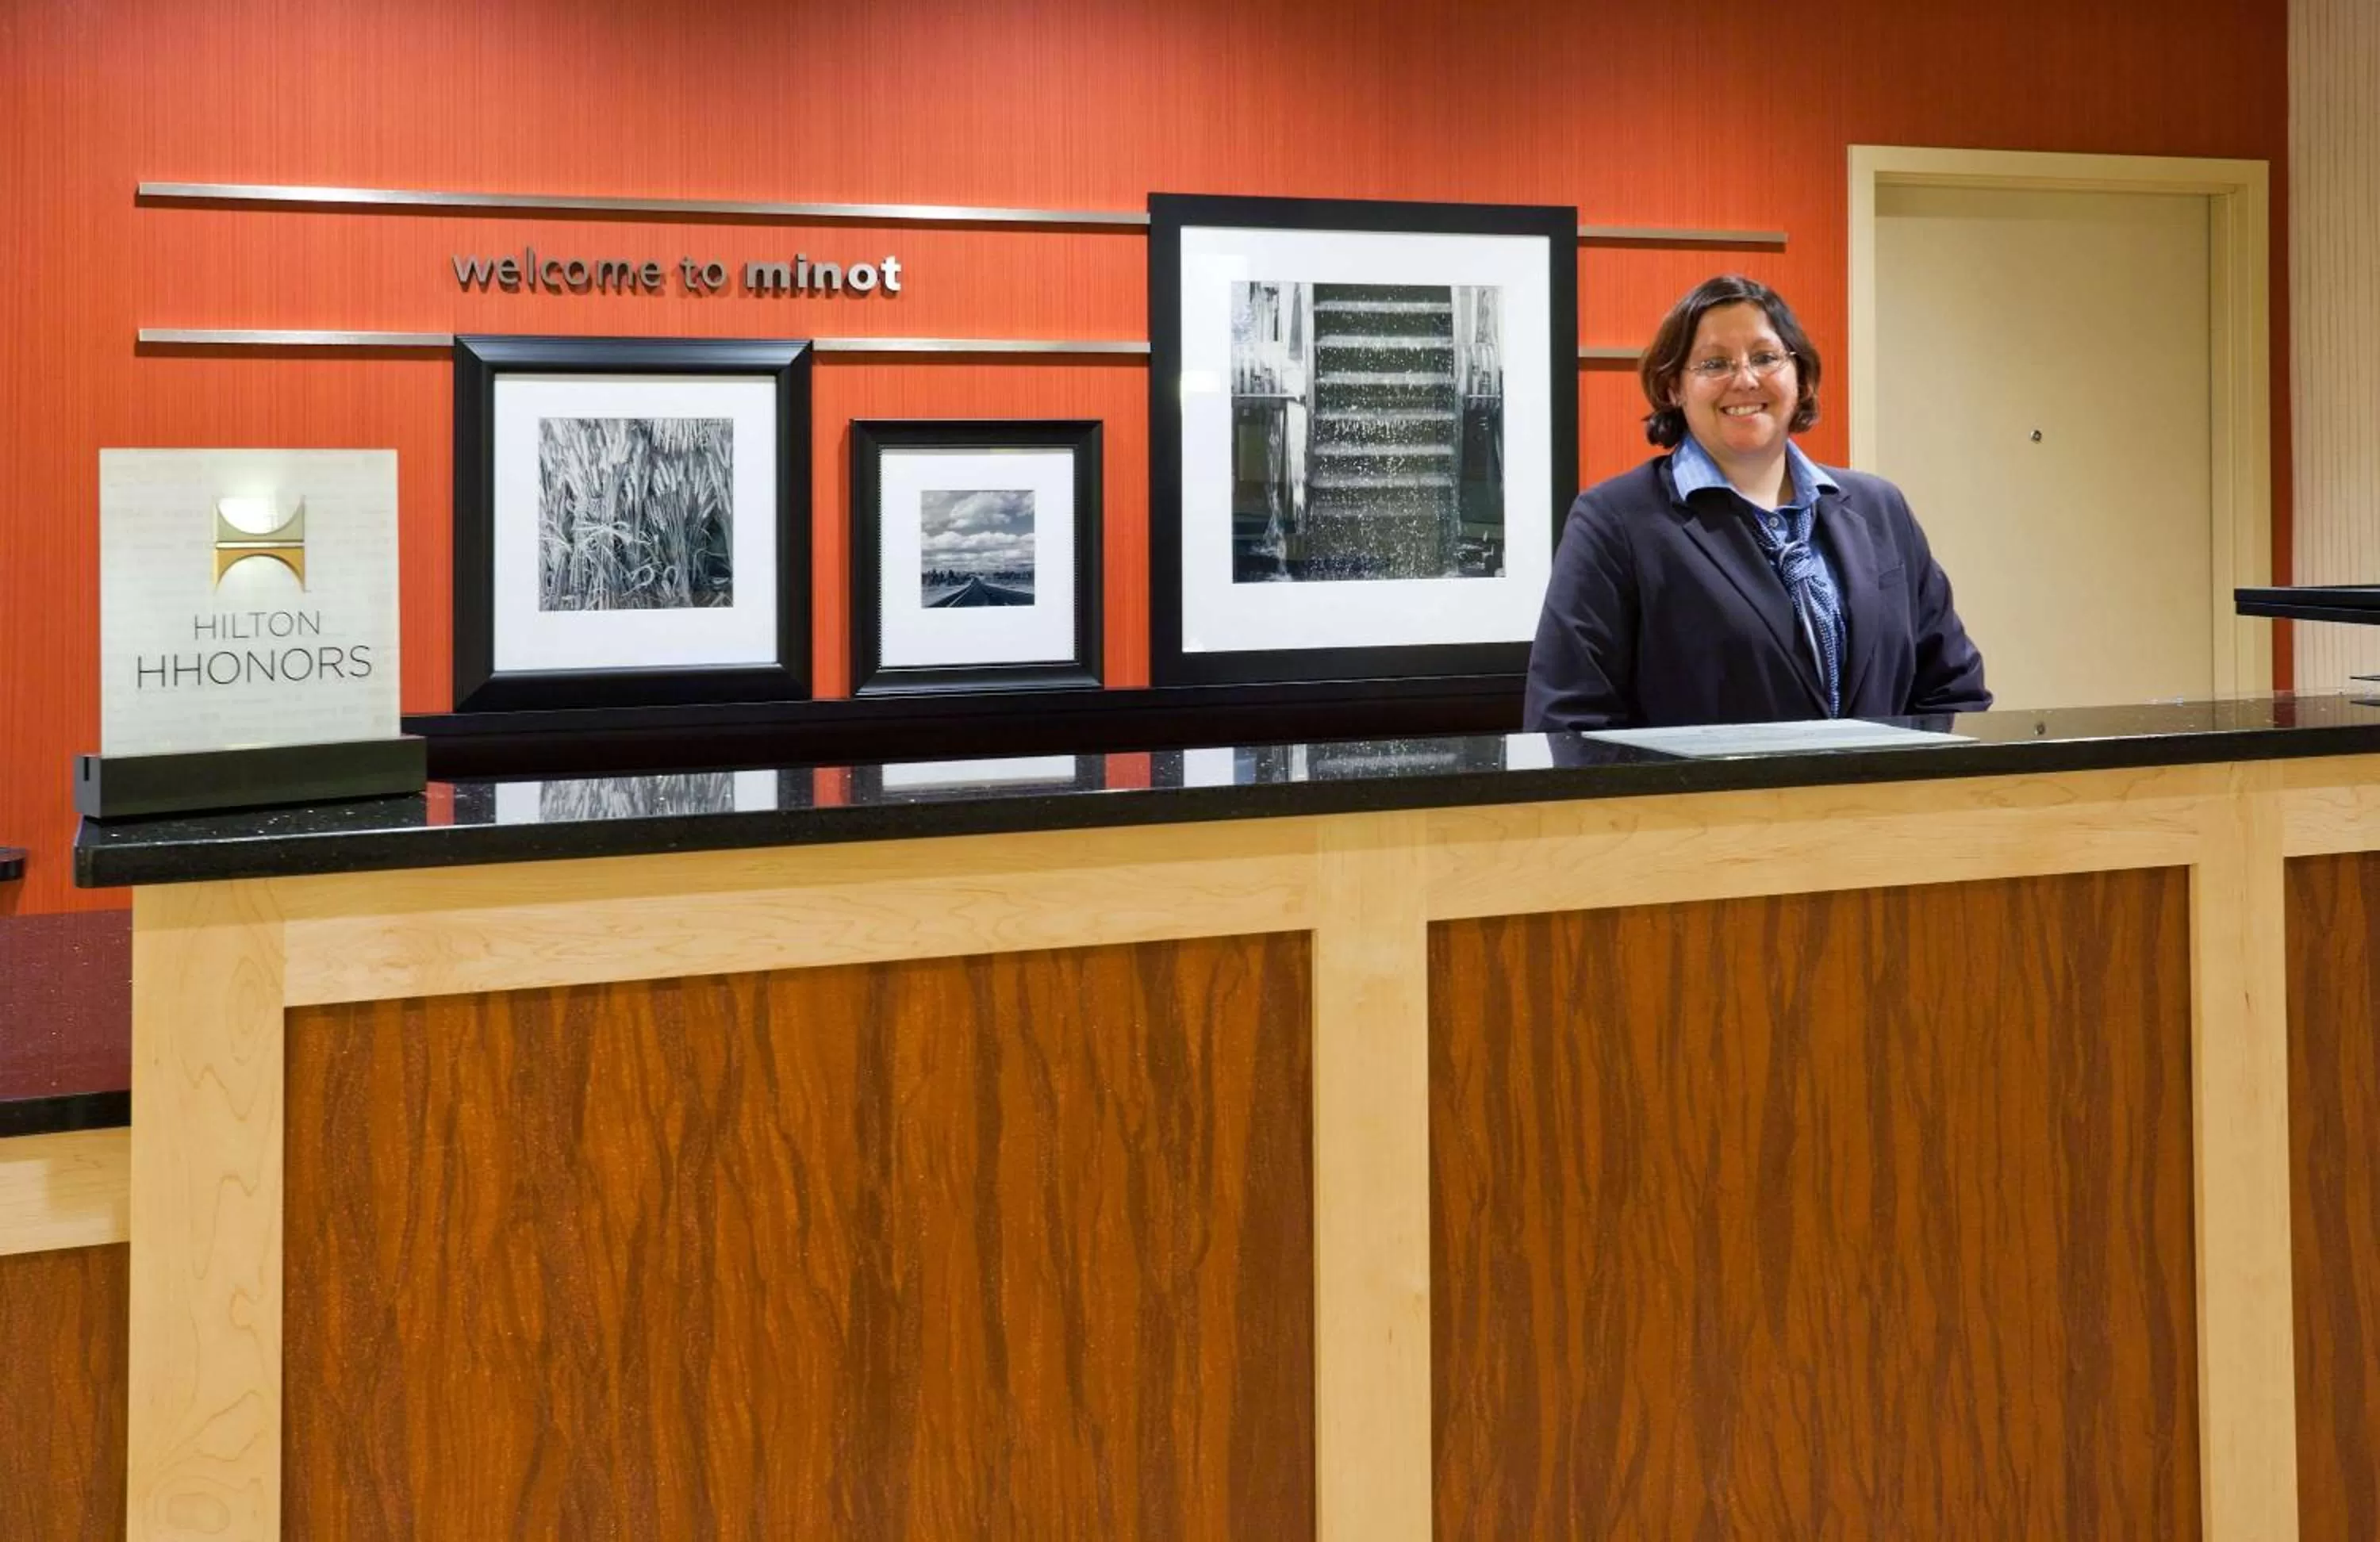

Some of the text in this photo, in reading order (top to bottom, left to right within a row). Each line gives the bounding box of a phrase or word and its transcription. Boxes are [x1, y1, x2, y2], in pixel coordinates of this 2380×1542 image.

[451, 247, 902, 293] welcome to minot
[194, 610, 321, 640] HILTON
[137, 645, 372, 689] HHONORS
